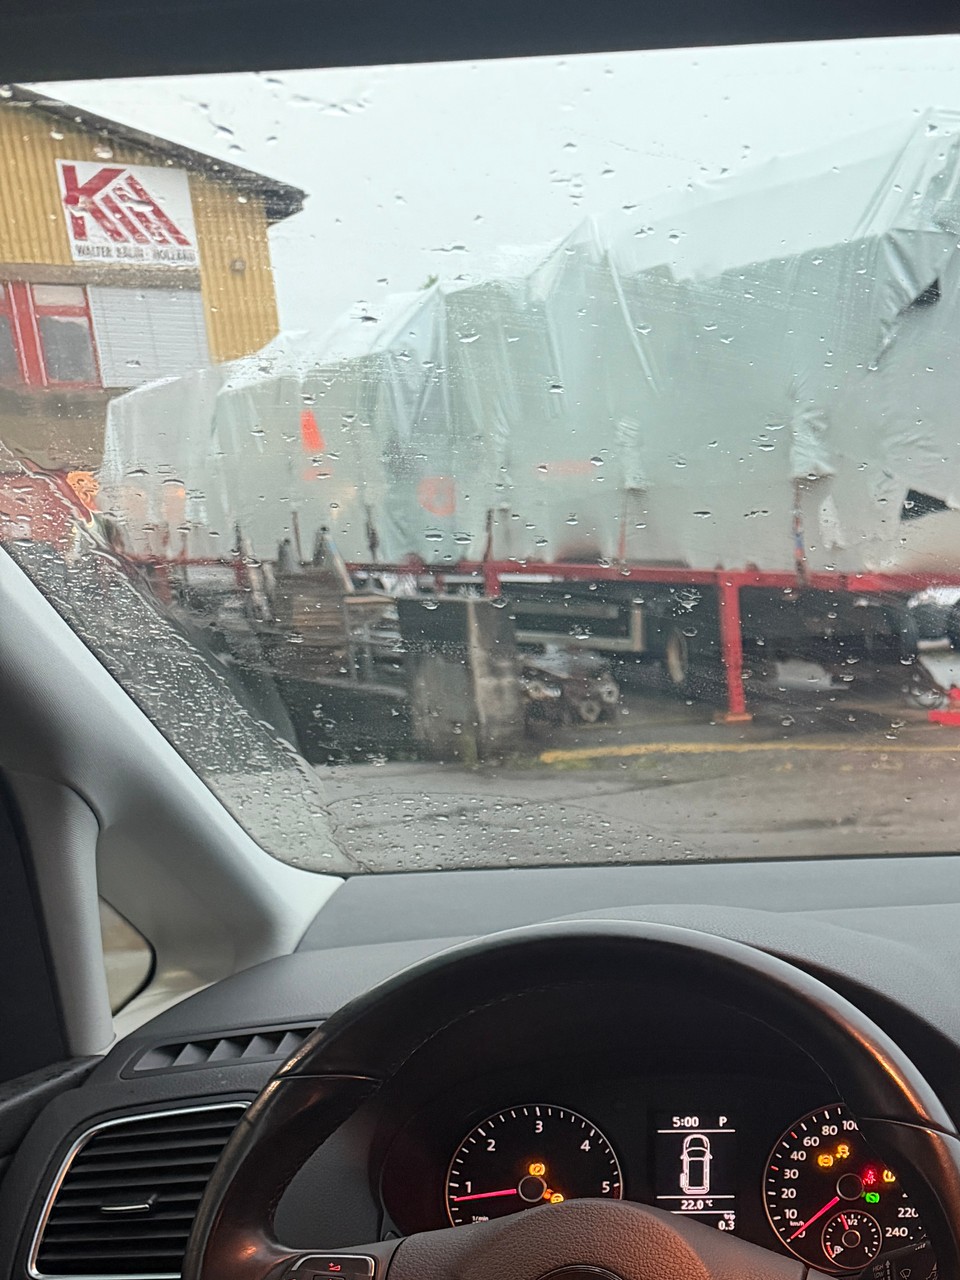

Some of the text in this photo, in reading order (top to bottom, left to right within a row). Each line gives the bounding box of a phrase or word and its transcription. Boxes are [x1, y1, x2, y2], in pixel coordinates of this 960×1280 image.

[535, 1120, 543, 1133] 3
[672, 1116, 728, 1128] 5:00 P
[821, 1125, 838, 1136] 80
[487, 1139, 496, 1151] 2
[580, 1139, 591, 1151] 4
[803, 1136, 820, 1147] 60
[790, 1150, 807, 1161] 40
[783, 1169, 799, 1180] 30
[465, 1181, 472, 1193] 1
[601, 1181, 610, 1193] 5
[781, 1188, 797, 1199] 20
[681, 1199, 704, 1210] 22.0
[784, 1208, 798, 1219] 10
[718, 1220, 735, 1231] 0.3
[847, 1218, 859, 1226] 1/2
[885, 1227, 908, 1237] 240
